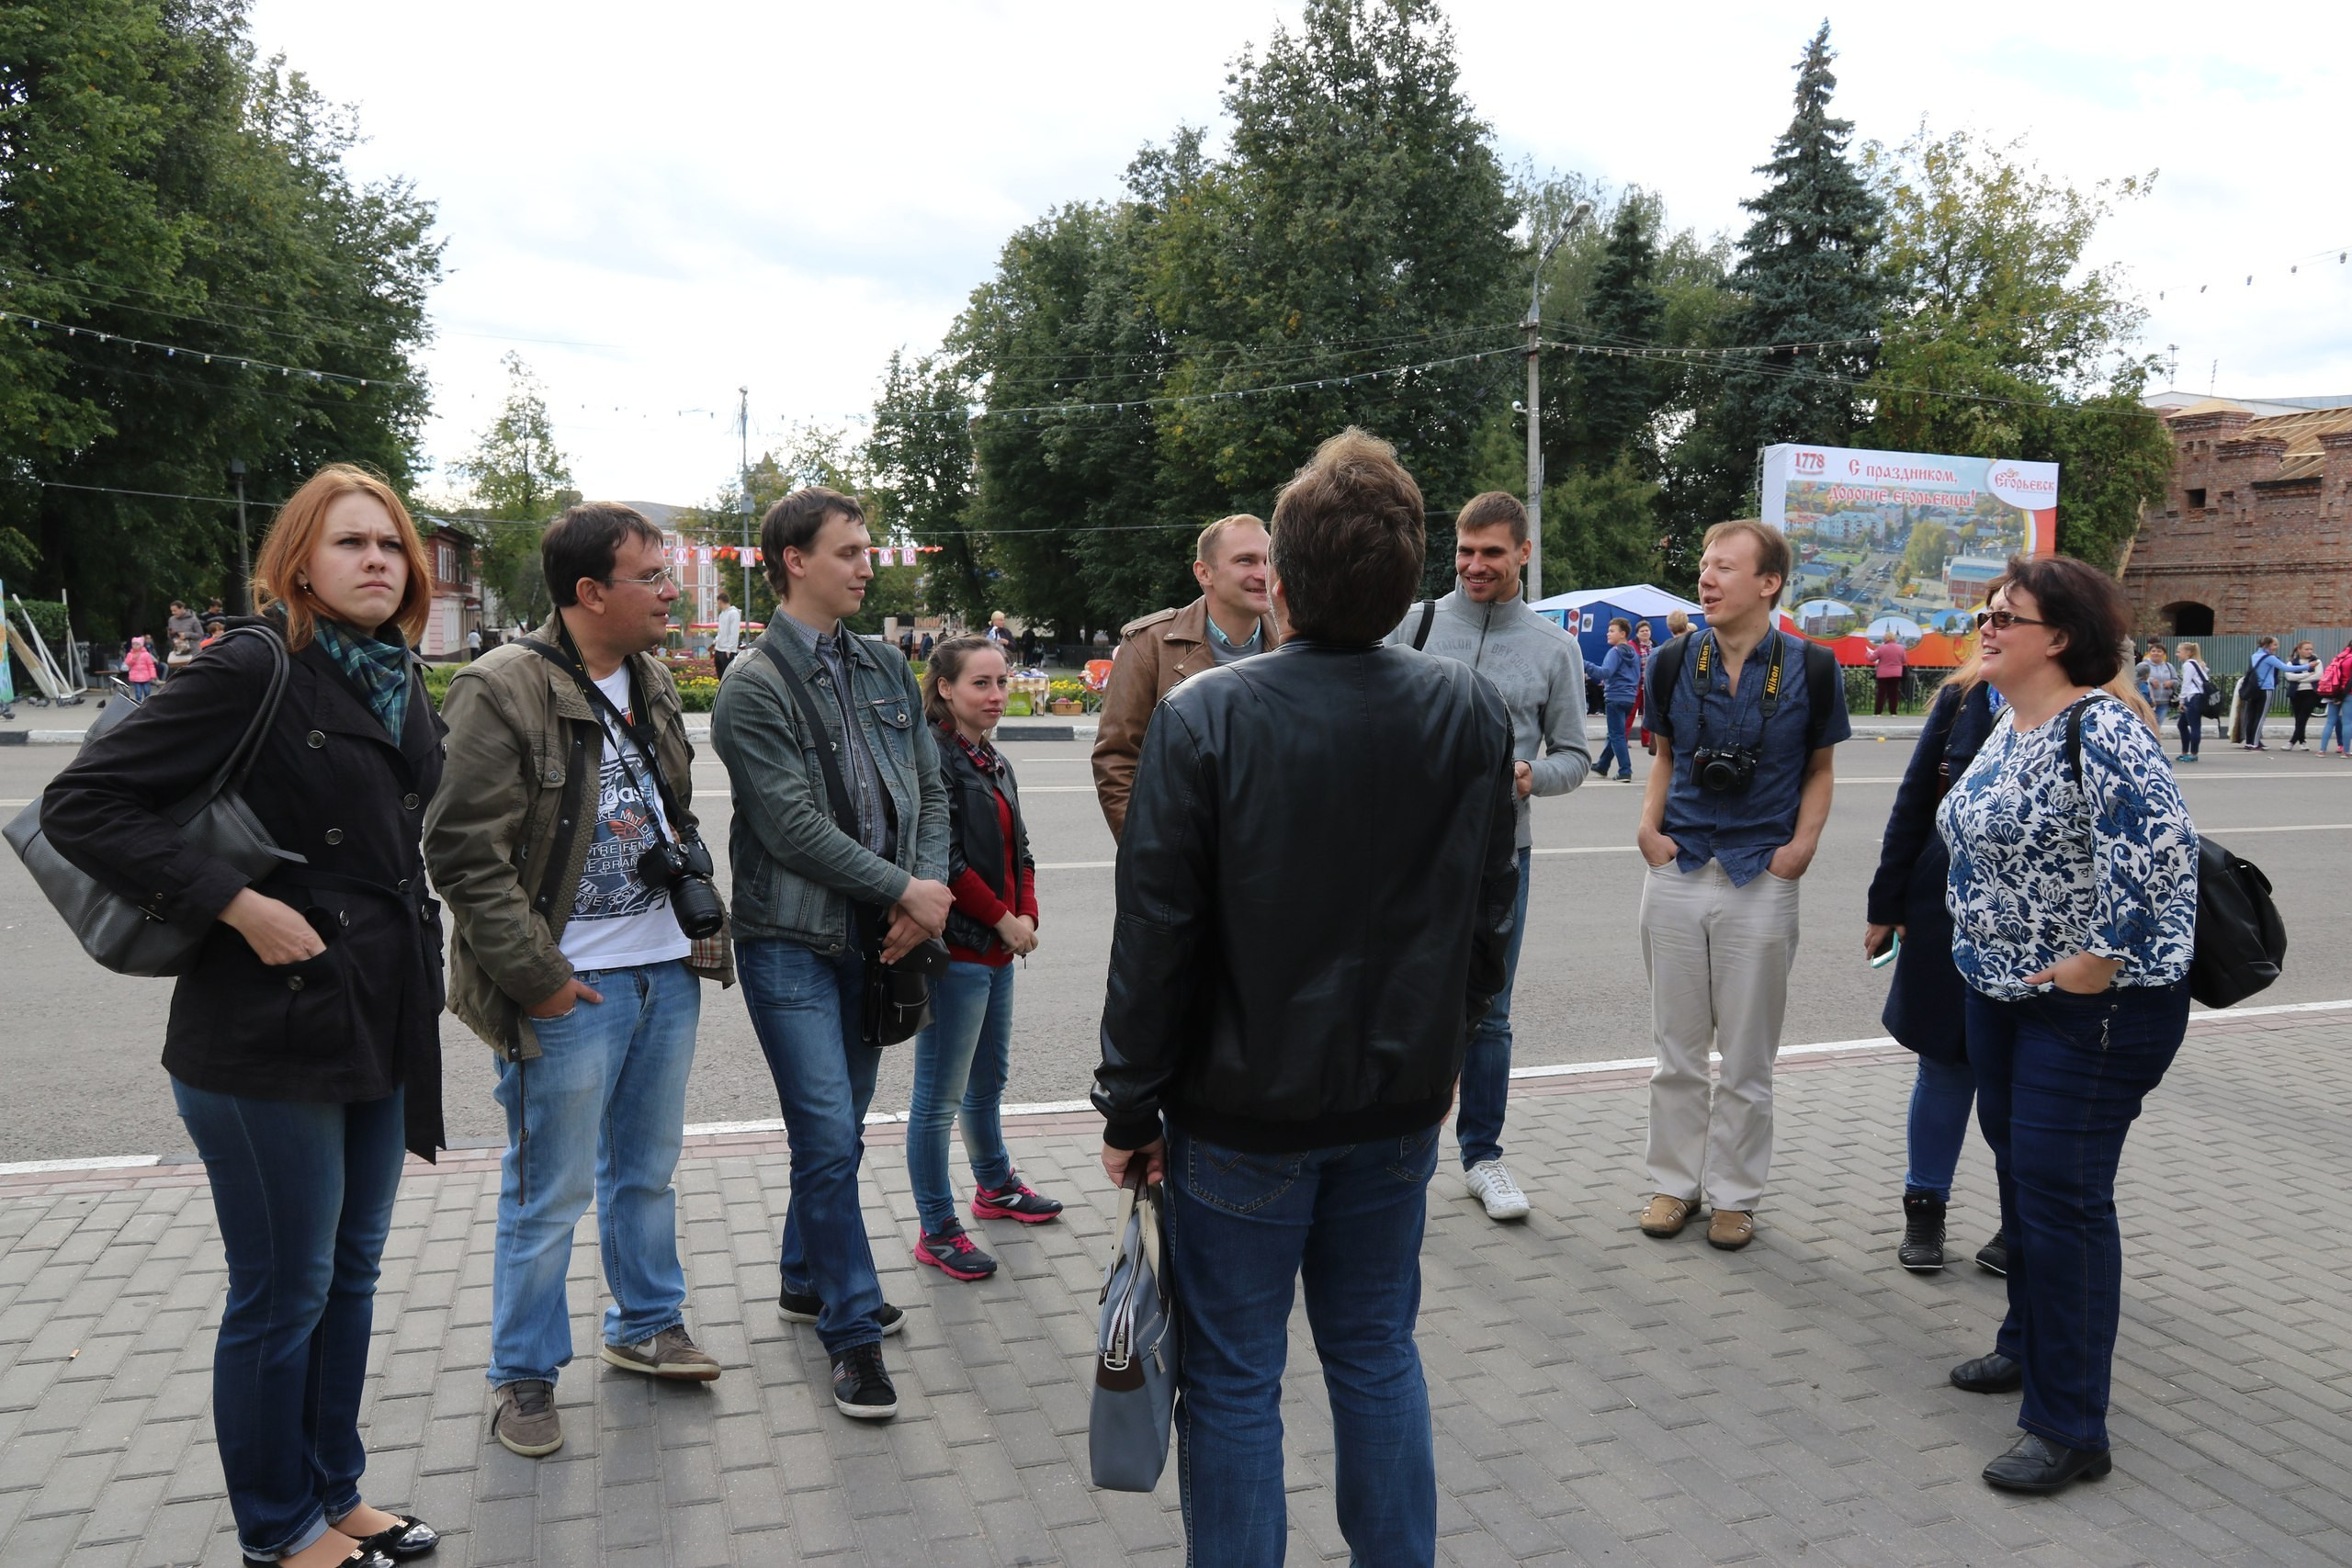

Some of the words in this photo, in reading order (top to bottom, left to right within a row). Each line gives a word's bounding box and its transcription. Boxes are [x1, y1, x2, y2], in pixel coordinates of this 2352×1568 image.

[1794, 452, 1825, 469] 1778
[1849, 458, 1860, 476] С
[1866, 465, 1958, 484] праздником,
[1995, 471, 2055, 492] Егорьевск
[1893, 489, 1975, 507] егорьевцы!
[1698, 645, 1710, 671] Nikon
[1767, 665, 1780, 694] Nikon
[620, 810, 641, 825] MIT
[589, 841, 645, 856] TREIFEN
[574, 892, 604, 906] THE
